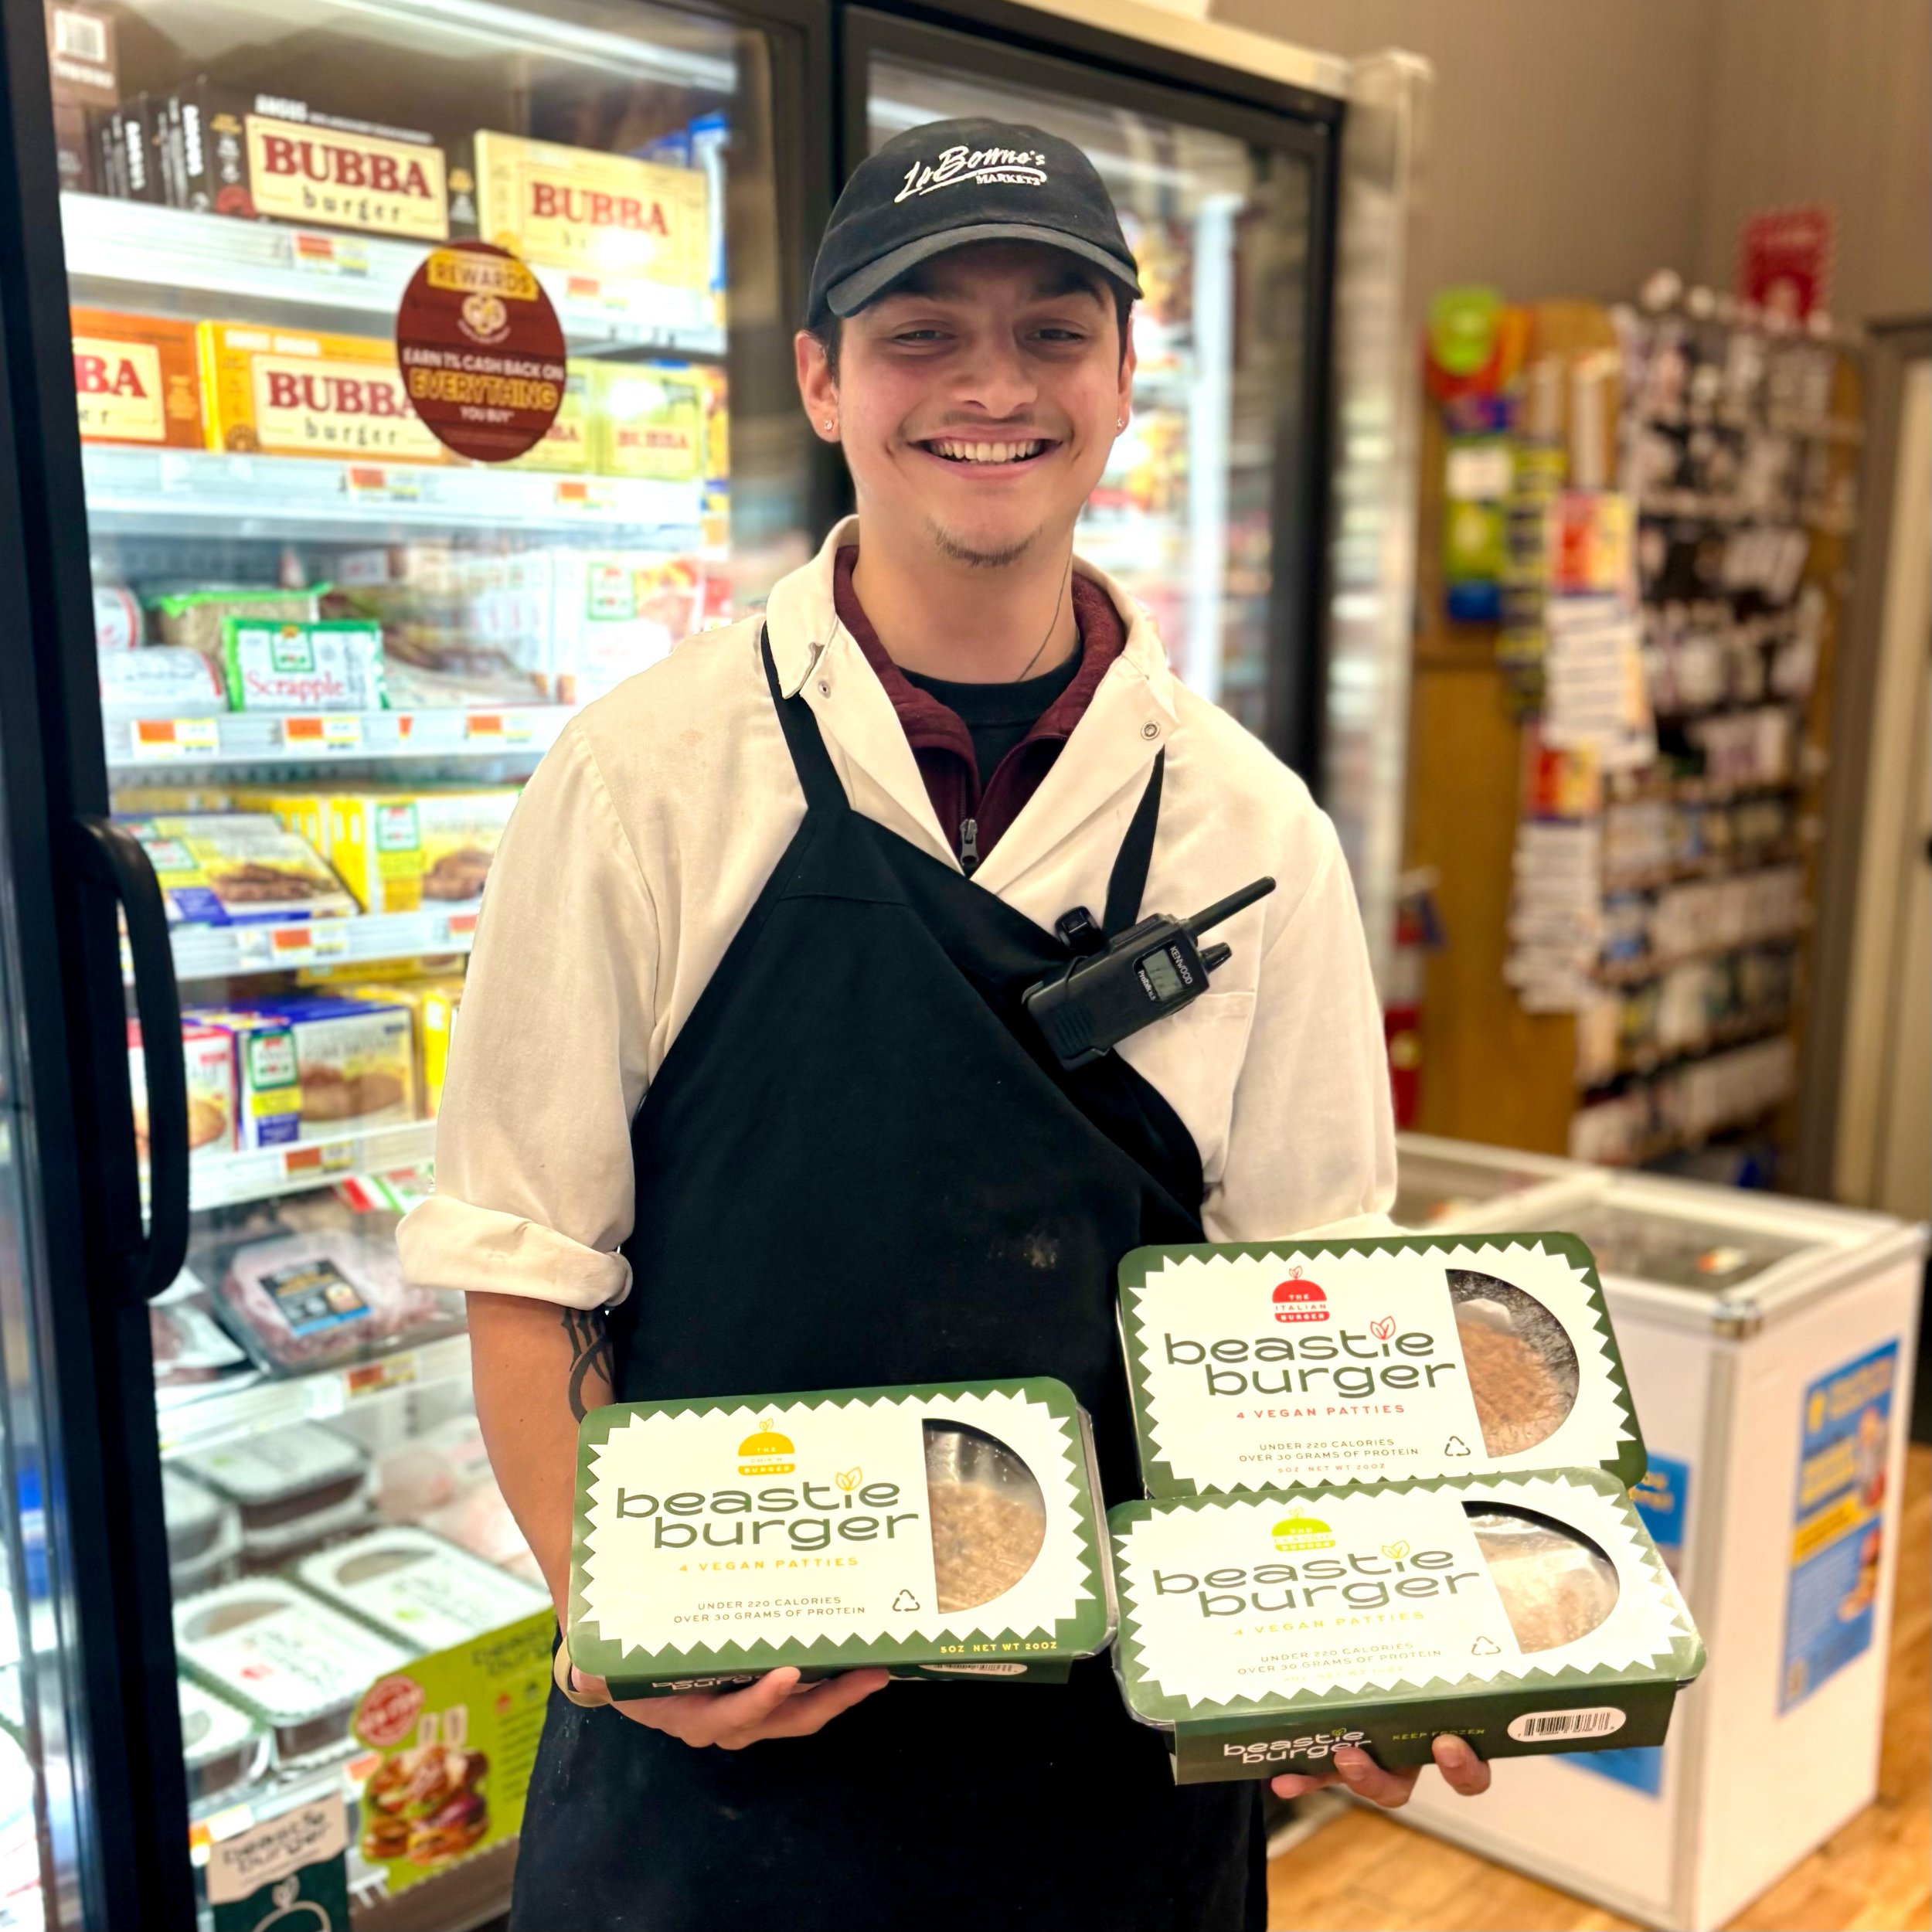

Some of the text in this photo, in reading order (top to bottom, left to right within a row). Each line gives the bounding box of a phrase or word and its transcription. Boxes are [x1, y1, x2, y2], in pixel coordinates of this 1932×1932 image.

[262, 134, 432, 199] BUBBA
[976, 172, 1041, 186] MARKETS
[303, 187, 401, 223] burger
[531, 182, 669, 237] BUBBA
[437, 261, 532, 294] REWARDS
[403, 348, 441, 367] EARN
[461, 355, 501, 373] CASH
[504, 359, 540, 377] BACK
[543, 364, 564, 379] ON
[410, 366, 559, 411] EVERYTHING
[460, 406, 485, 421] YOU
[304, 416, 399, 447] burger
[246, 670, 343, 704] Scrapple
[1170, 946, 1193, 985] KENWOOD
[1163, 1328, 1434, 1366] beastie
[1204, 1361, 1455, 1399] burger
[1254, 1408, 1316, 1418] VEGAN
[1327, 1404, 1404, 1415] PATTIES
[1260, 1442, 1302, 1451] UNDER
[1332, 1439, 1394, 1447] CALORIES
[1296, 1451, 1339, 1460] GRAMS
[1364, 1448, 1419, 1457] PROTEIN
[616, 1478, 900, 1519] beastie
[653, 1512, 919, 1551] burger
[699, 1560, 764, 1571] VEGAN
[775, 1557, 859, 1569] PATTIES
[1153, 1549, 1454, 1596] beastie
[698, 1600, 743, 1611] UNDER
[774, 1597, 842, 1607] CALORIES
[1198, 1569, 1480, 1618] burger
[674, 1606, 866, 1624] OVER 30 GRAMS OF PROTEIN
[1254, 1620, 1324, 1634] VEGAN
[1335, 1611, 1424, 1626] PATTIES
[973, 1643, 997, 1652] NET
[1002, 1642, 1020, 1651] WT
[1260, 1651, 1309, 1663] UNDER
[1342, 1642, 1414, 1655] CALORIES
[1237, 1665, 1275, 1675] OVER
[1302, 1658, 1352, 1668] GRAMS
[1379, 1650, 1442, 1661] PROTEIN
[1223, 1729, 1365, 1757] beastie
[1393, 1732, 1427, 1740] KEEP
[1242, 1740, 1372, 1764] burger
